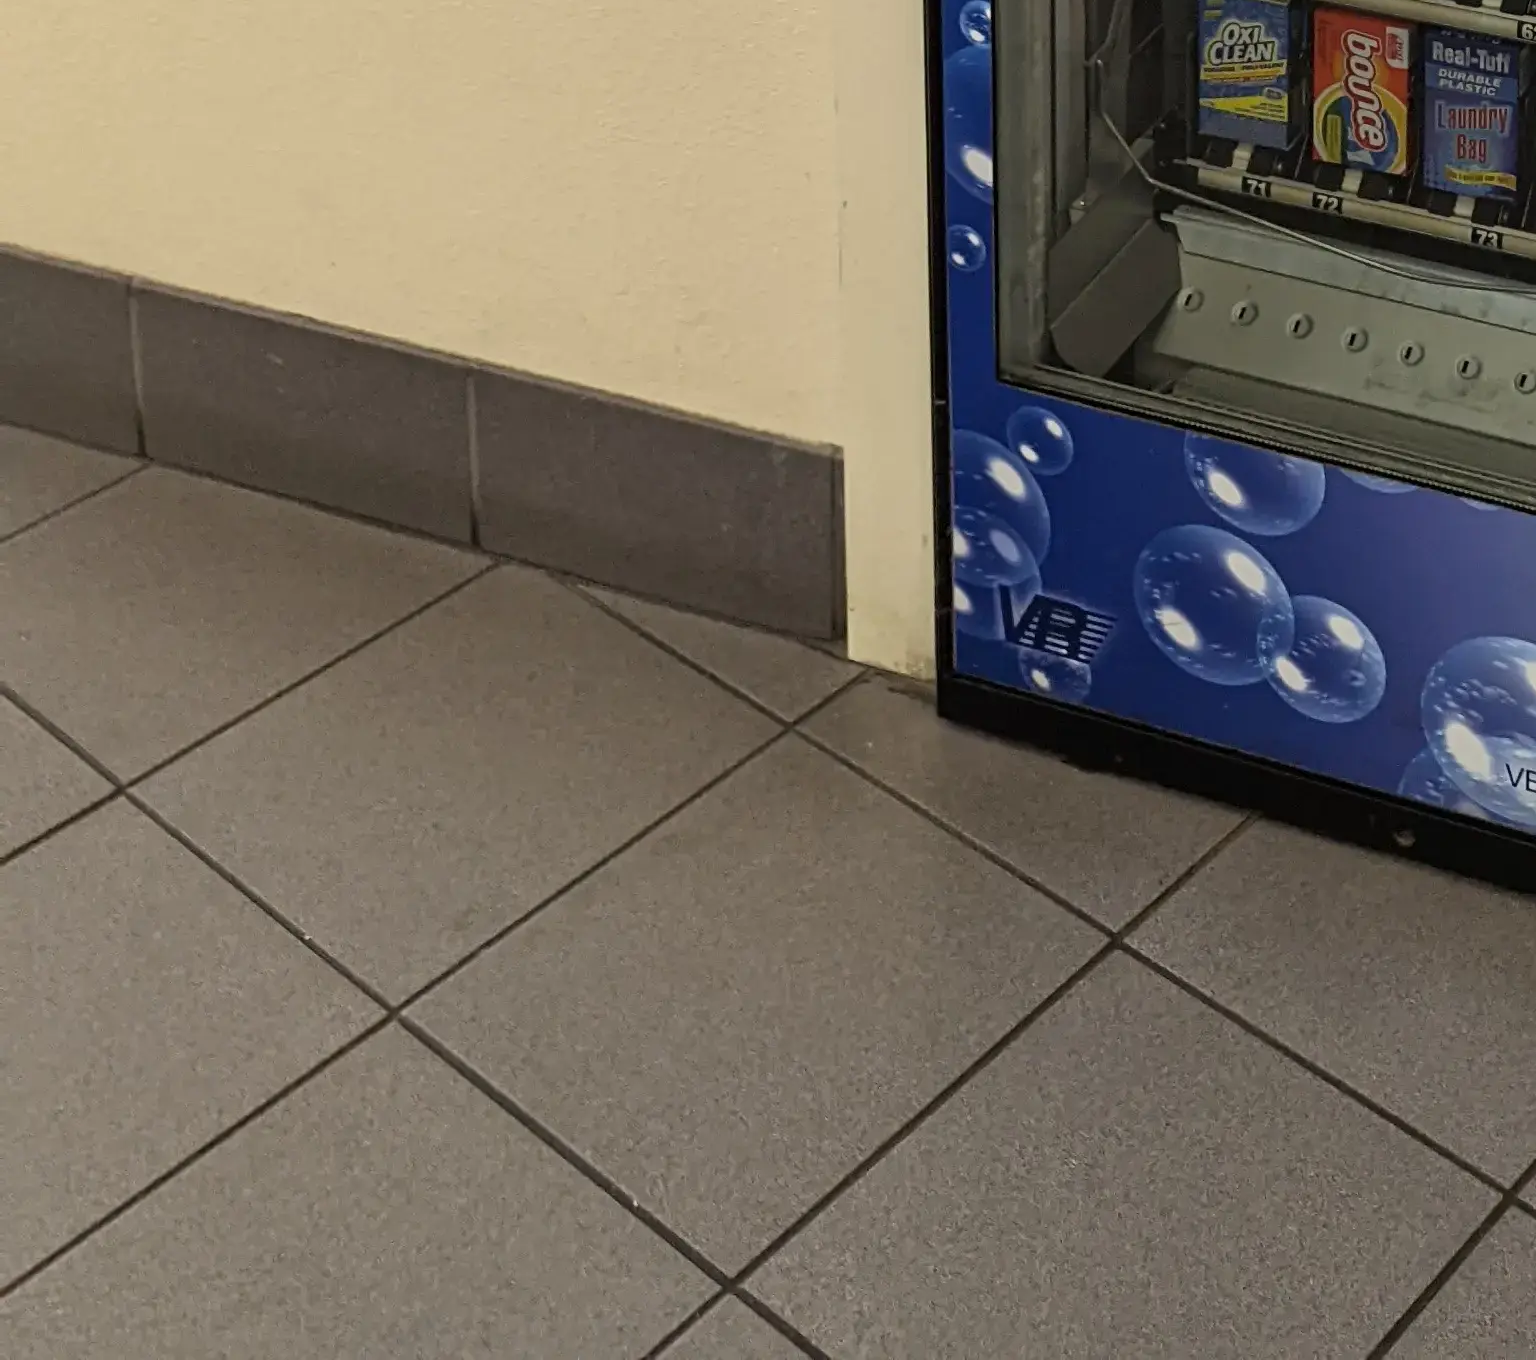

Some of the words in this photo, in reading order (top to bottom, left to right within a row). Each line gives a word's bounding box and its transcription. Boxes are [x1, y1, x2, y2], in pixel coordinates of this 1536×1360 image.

[1223, 22, 1262, 46] OXI
[1208, 41, 1275, 66] CLEAN
[1432, 40, 1511, 75] Real-Tuff
[1438, 68, 1502, 88] DURABLE
[1439, 79, 1497, 97] PLASTIC
[1346, 31, 1386, 150] bounce
[1436, 103, 1509, 135] Laundry
[1456, 133, 1487, 164] Bag
[1244, 180, 1269, 198] 71
[1316, 194, 1341, 211] 72
[1475, 229, 1499, 248] 73
